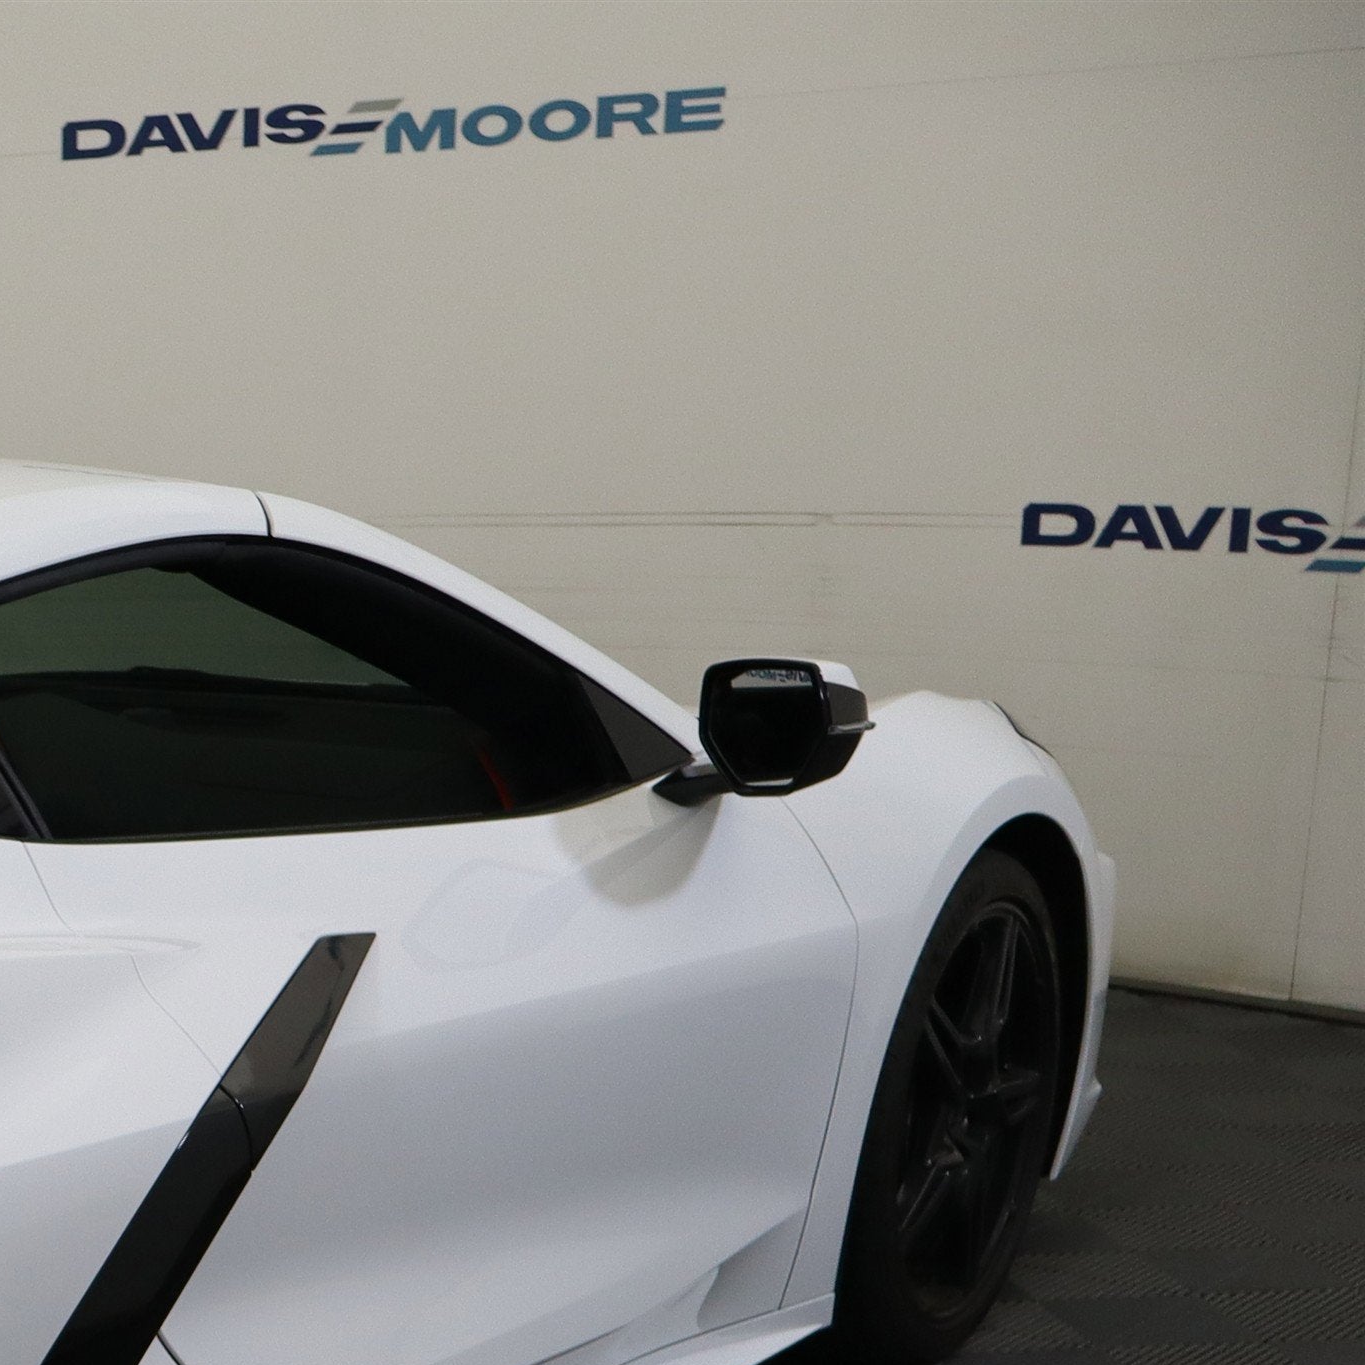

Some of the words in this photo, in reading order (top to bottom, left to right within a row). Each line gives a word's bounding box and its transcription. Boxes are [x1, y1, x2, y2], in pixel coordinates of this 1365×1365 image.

[61, 103, 327, 162] DAVIS
[384, 86, 727, 155] MOORE
[1020, 502, 1330, 556] DAVIS
